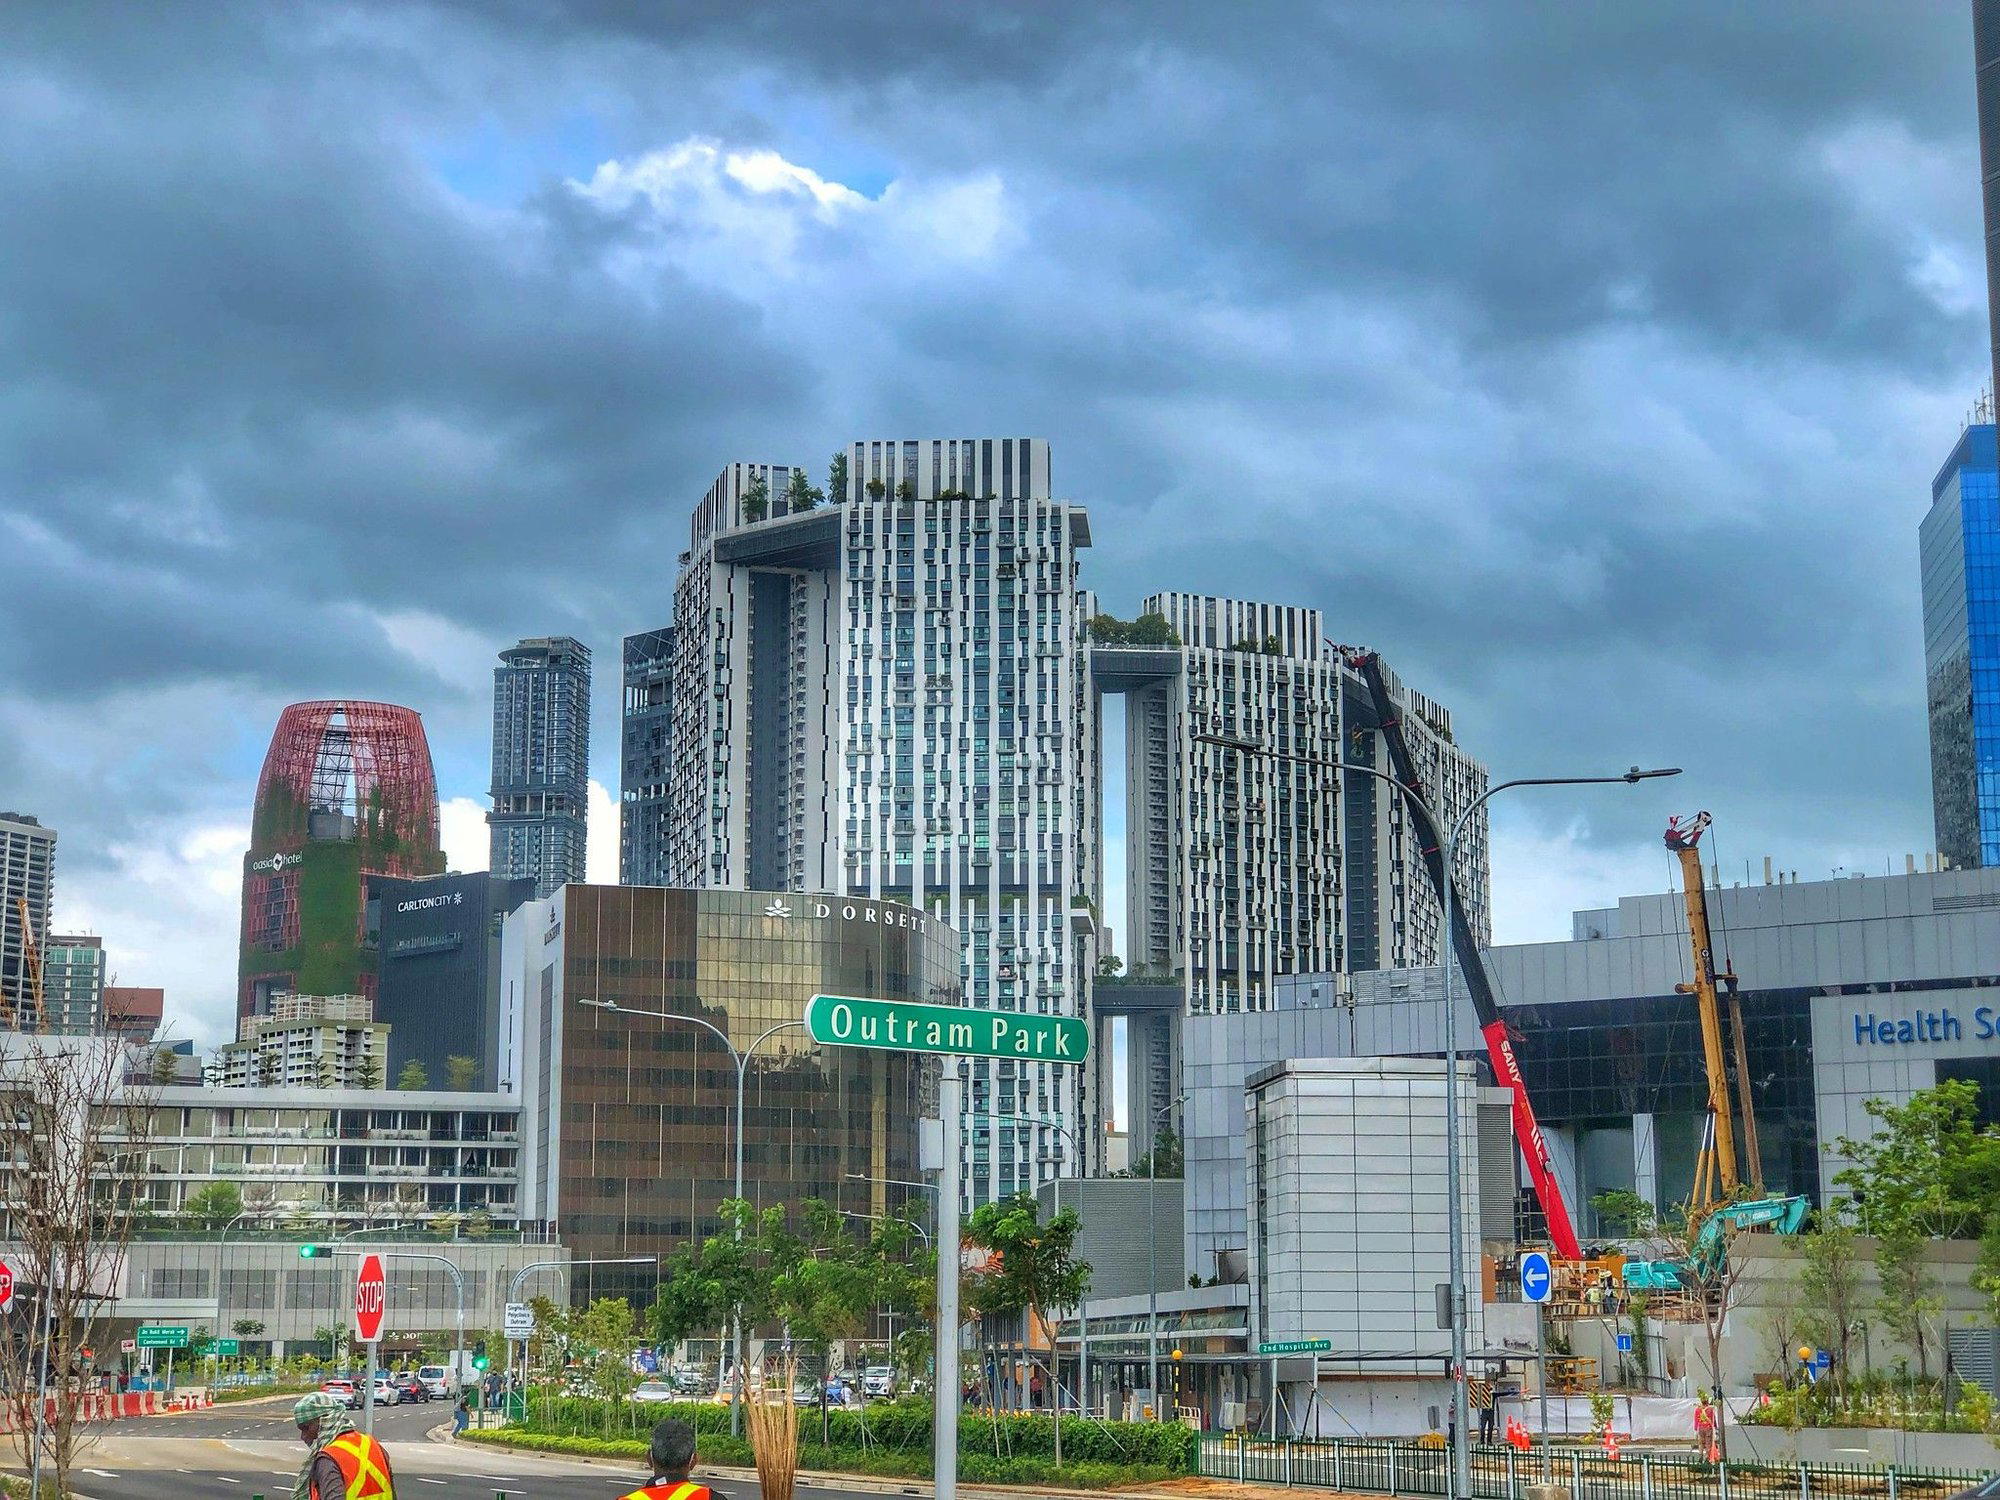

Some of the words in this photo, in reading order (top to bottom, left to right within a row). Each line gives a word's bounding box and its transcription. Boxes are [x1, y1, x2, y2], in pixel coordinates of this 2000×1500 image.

[282, 850, 303, 865] hotel
[815, 903, 926, 934] DORSETT
[831, 1004, 974, 1049] Outram
[992, 1018, 1071, 1056] Park
[1854, 1008, 1961, 1045] Health
[1974, 1007, 2000, 1040] S
[1500, 1040, 1522, 1083] SANY
[358, 1280, 384, 1313] STOP
[1279, 1342, 1312, 1351] Hospital
